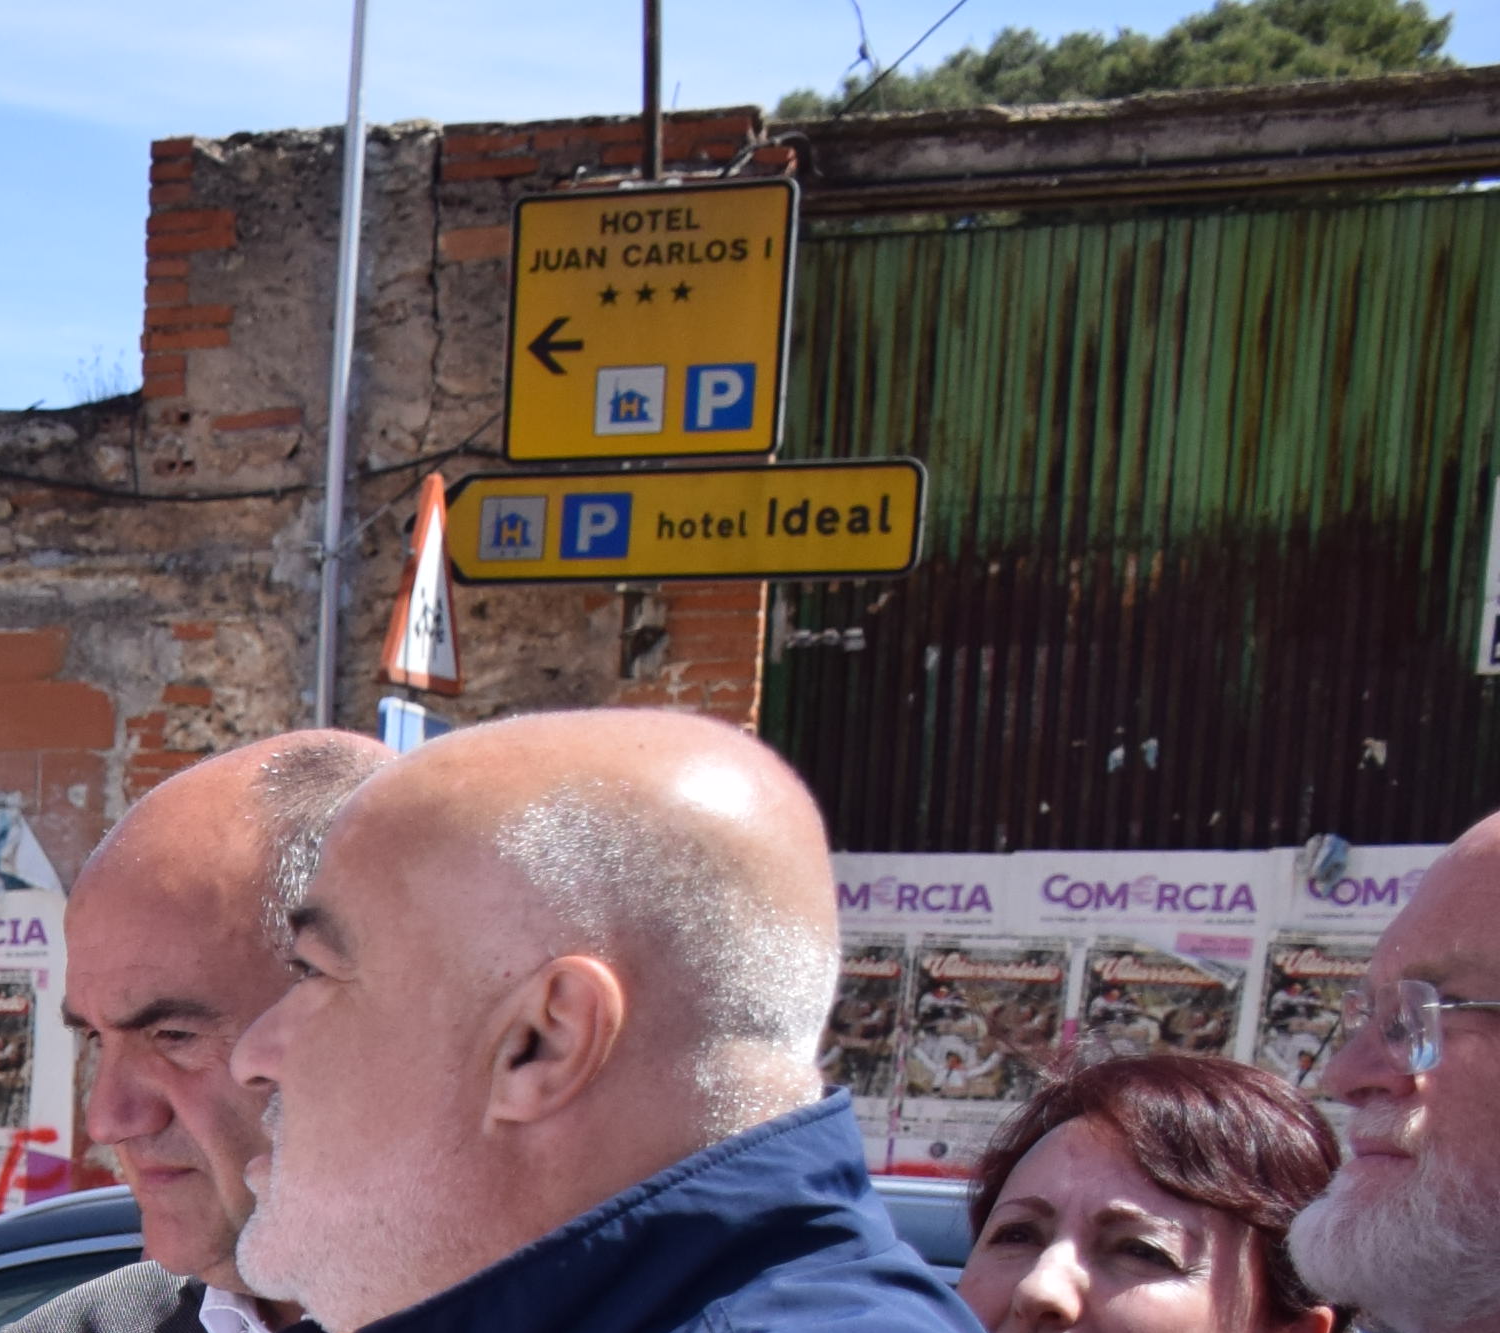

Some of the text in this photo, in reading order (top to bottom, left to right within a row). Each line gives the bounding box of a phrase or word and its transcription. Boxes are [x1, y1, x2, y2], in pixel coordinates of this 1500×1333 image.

[600, 208, 700, 235] HOTEL
[530, 237, 773, 273] JUAN CARLOS I
[696, 368, 745, 429] P
[576, 503, 618, 554] P
[656, 511, 749, 541] hotel
[766, 495, 893, 537] Ideal
